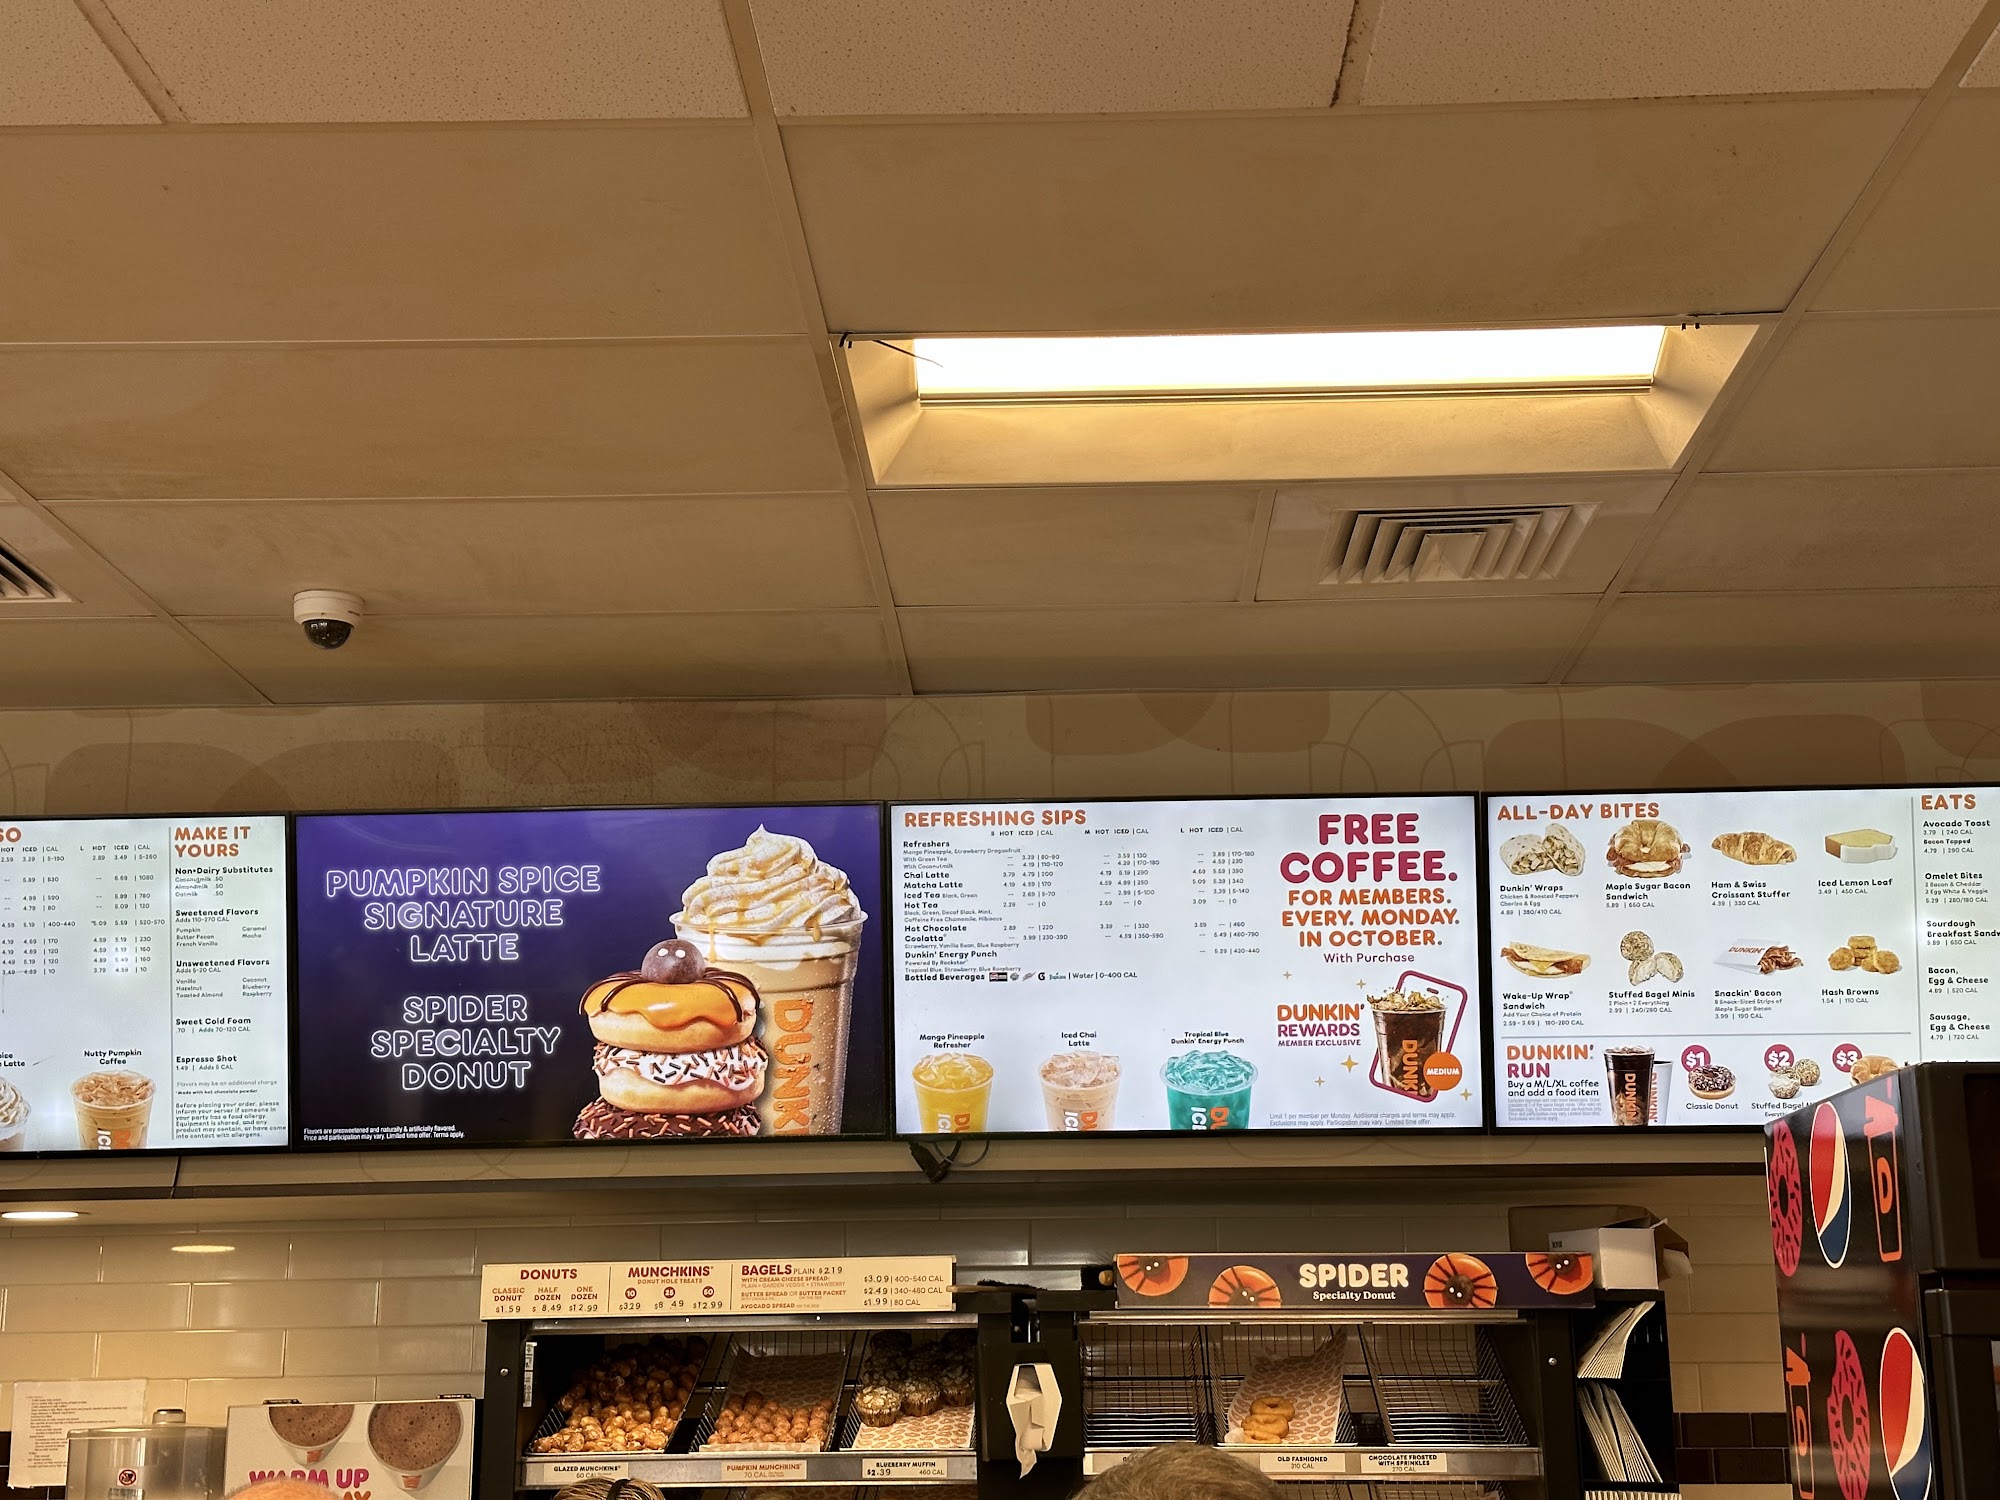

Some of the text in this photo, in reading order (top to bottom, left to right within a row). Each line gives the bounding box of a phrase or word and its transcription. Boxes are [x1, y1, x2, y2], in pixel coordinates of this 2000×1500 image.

[1921, 794, 1976, 810] EATS
[905, 809, 1086, 827] REFRESHING SIPS
[1497, 803, 1659, 821] ALL-DAY BITES
[175, 826, 251, 841] MAKE IT
[1319, 813, 1419, 845] FREE
[174, 843, 239, 858] YOURS
[1280, 850, 1458, 884] COFFEE.
[326, 865, 600, 898] PUMPKIN SPICE
[1606, 883, 1632, 891] Maple
[1635, 883, 1661, 891] Sugar
[1818, 879, 1837, 887] Iced
[1872, 878, 1892, 886] Loaf
[1534, 885, 1563, 893] Wraps
[1606, 890, 1650, 900] Sandwich
[1757, 890, 1790, 898] Stuffer
[1289, 888, 1451, 906] FOR MEMBERS.
[364, 899, 563, 930] SIGNATURE
[1282, 908, 1460, 926] EVERY. MONDAY.
[1927, 920, 1975, 928] Sourdough
[1300, 930, 1442, 947] IN OCTOBER.
[410, 933, 519, 962] LATTE
[939, 951, 969, 959] Energy
[1323, 952, 1414, 963] With Purchase
[176, 959, 235, 967] Unsweetened
[940, 974, 985, 982] Beverages
[1929, 977, 1945, 986] Egg
[1608, 991, 1643, 1000] Stuffed
[1645, 991, 1669, 999] Bagel
[403, 994, 528, 1024] SPIDER
[1277, 1003, 1365, 1021] DUNKIN'
[1503, 1002, 1545, 1010] Sandwich
[205, 1017, 225, 1025] Cold
[1278, 1023, 1360, 1037] REWARDS
[371, 1026, 561, 1058] SPECIALTY
[919, 1033, 985, 1043] Mango Pineapple
[934, 1040, 971, 1048] Refresher
[108, 1049, 142, 1057] Pumpkin
[1507, 1044, 1594, 1060] DUNKIN'
[1768, 1050, 1790, 1068] $2
[1836, 1050, 1858, 1067] $3
[176, 1056, 214, 1064] Espresso
[1686, 1051, 1704, 1069] $1
[402, 1061, 532, 1090] DONUT
[1507, 1063, 1550, 1078] RUN
[1508, 1080, 1524, 1089] Buy
[1534, 1079, 1567, 1088] M/L/XL
[1569, 1079, 1599, 1087] coffee
[1508, 1088, 1525, 1096] and
[1527, 1088, 1545, 1096] add
[1555, 1088, 1576, 1096] food
[1579, 1088, 1599, 1096] item
[1782, 1102, 1804, 1110] Bagel
[520, 1269, 577, 1280] DONUTS
[742, 1264, 792, 1276] BAGELS
[1299, 1263, 1409, 1288] SPIDER
[1313, 1291, 1396, 1301] Specialty Donut
[336, 1468, 369, 1489] UP
